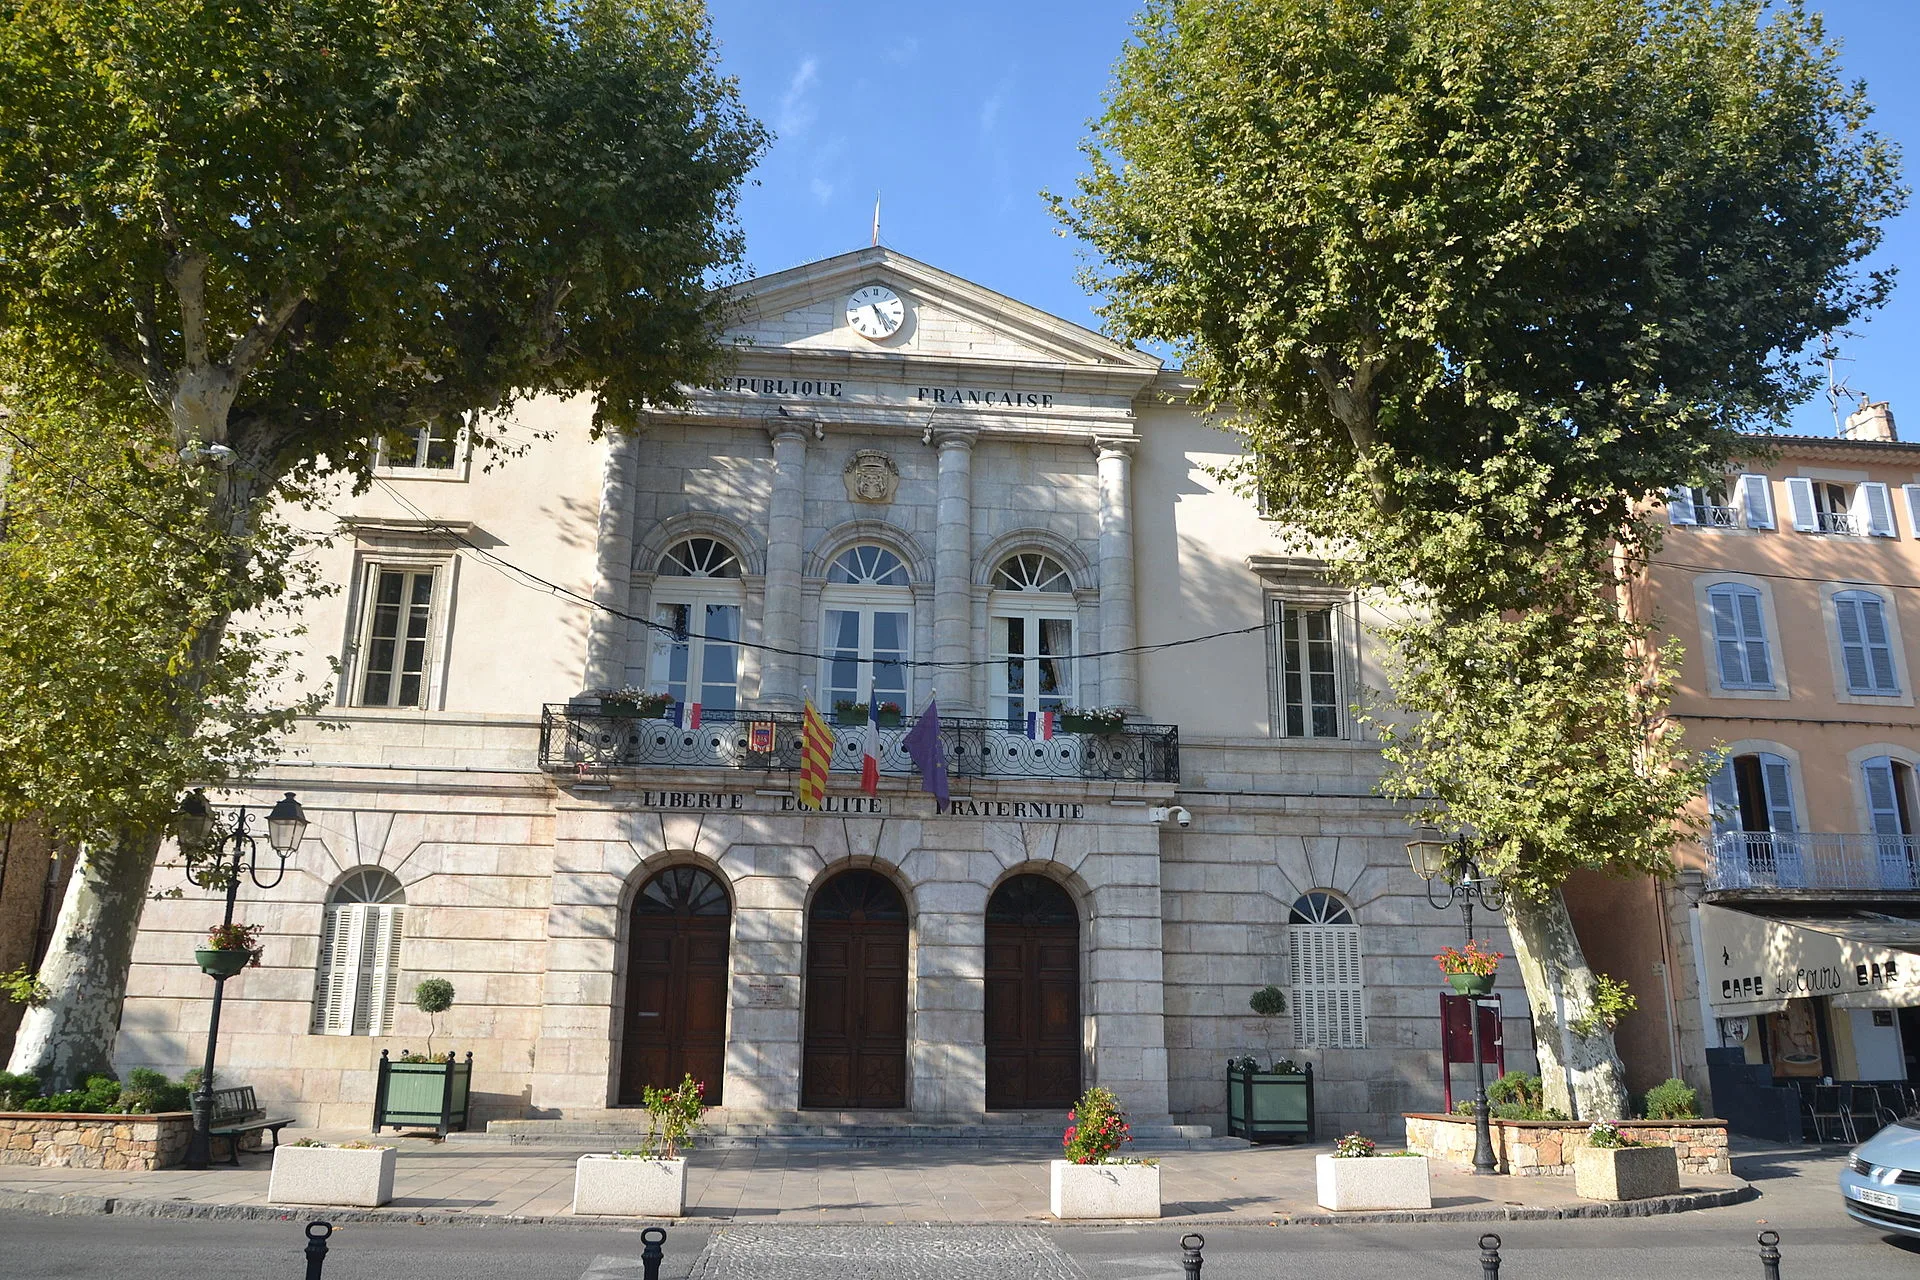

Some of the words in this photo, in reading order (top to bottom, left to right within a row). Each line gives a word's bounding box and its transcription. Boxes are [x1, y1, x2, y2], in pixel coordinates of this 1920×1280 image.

[917, 387, 1054, 408] FRANÇAISE
[643, 791, 744, 809] LIBERTE
[1722, 976, 1764, 999] CAFE
[1856, 961, 1898, 986] BAR
